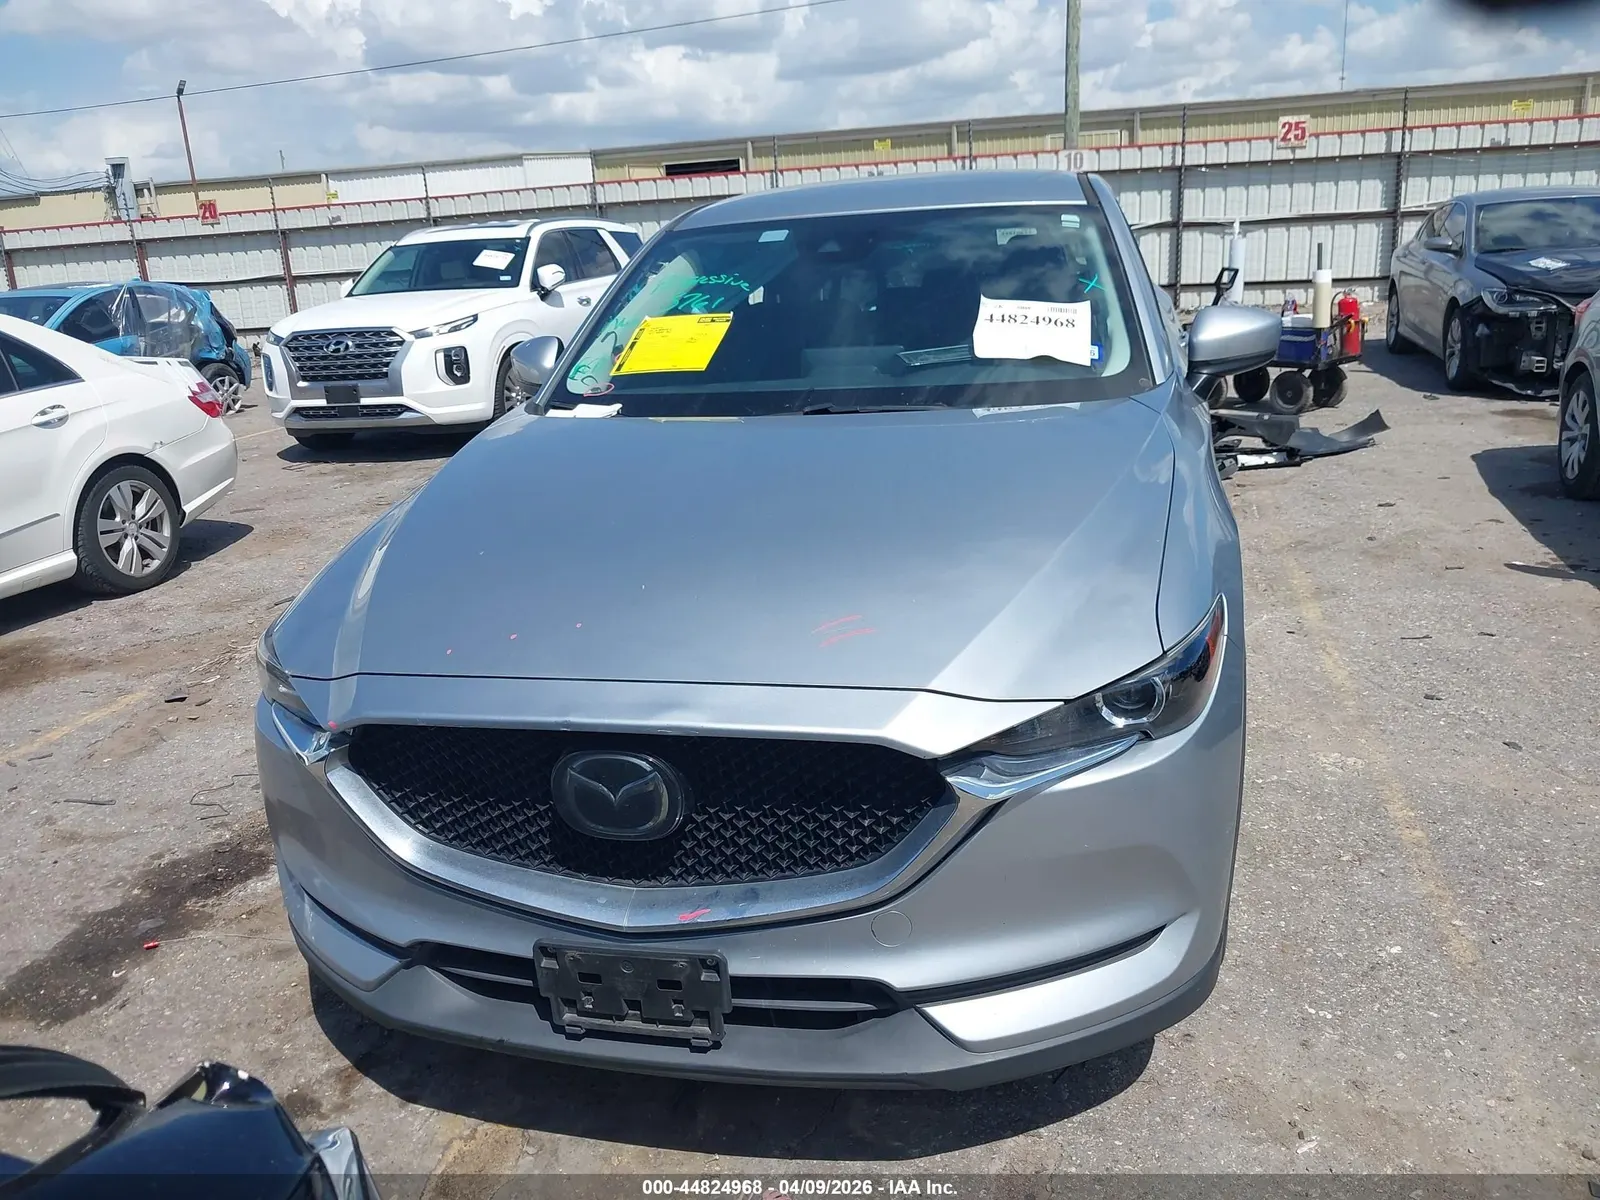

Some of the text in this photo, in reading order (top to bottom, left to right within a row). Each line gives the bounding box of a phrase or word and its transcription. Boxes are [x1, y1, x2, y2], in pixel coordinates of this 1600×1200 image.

[1280, 121, 1307, 143] 25
[1064, 151, 1084, 171] 10
[199, 203, 218, 220] 20
[984, 313, 1076, 328] 44824968
